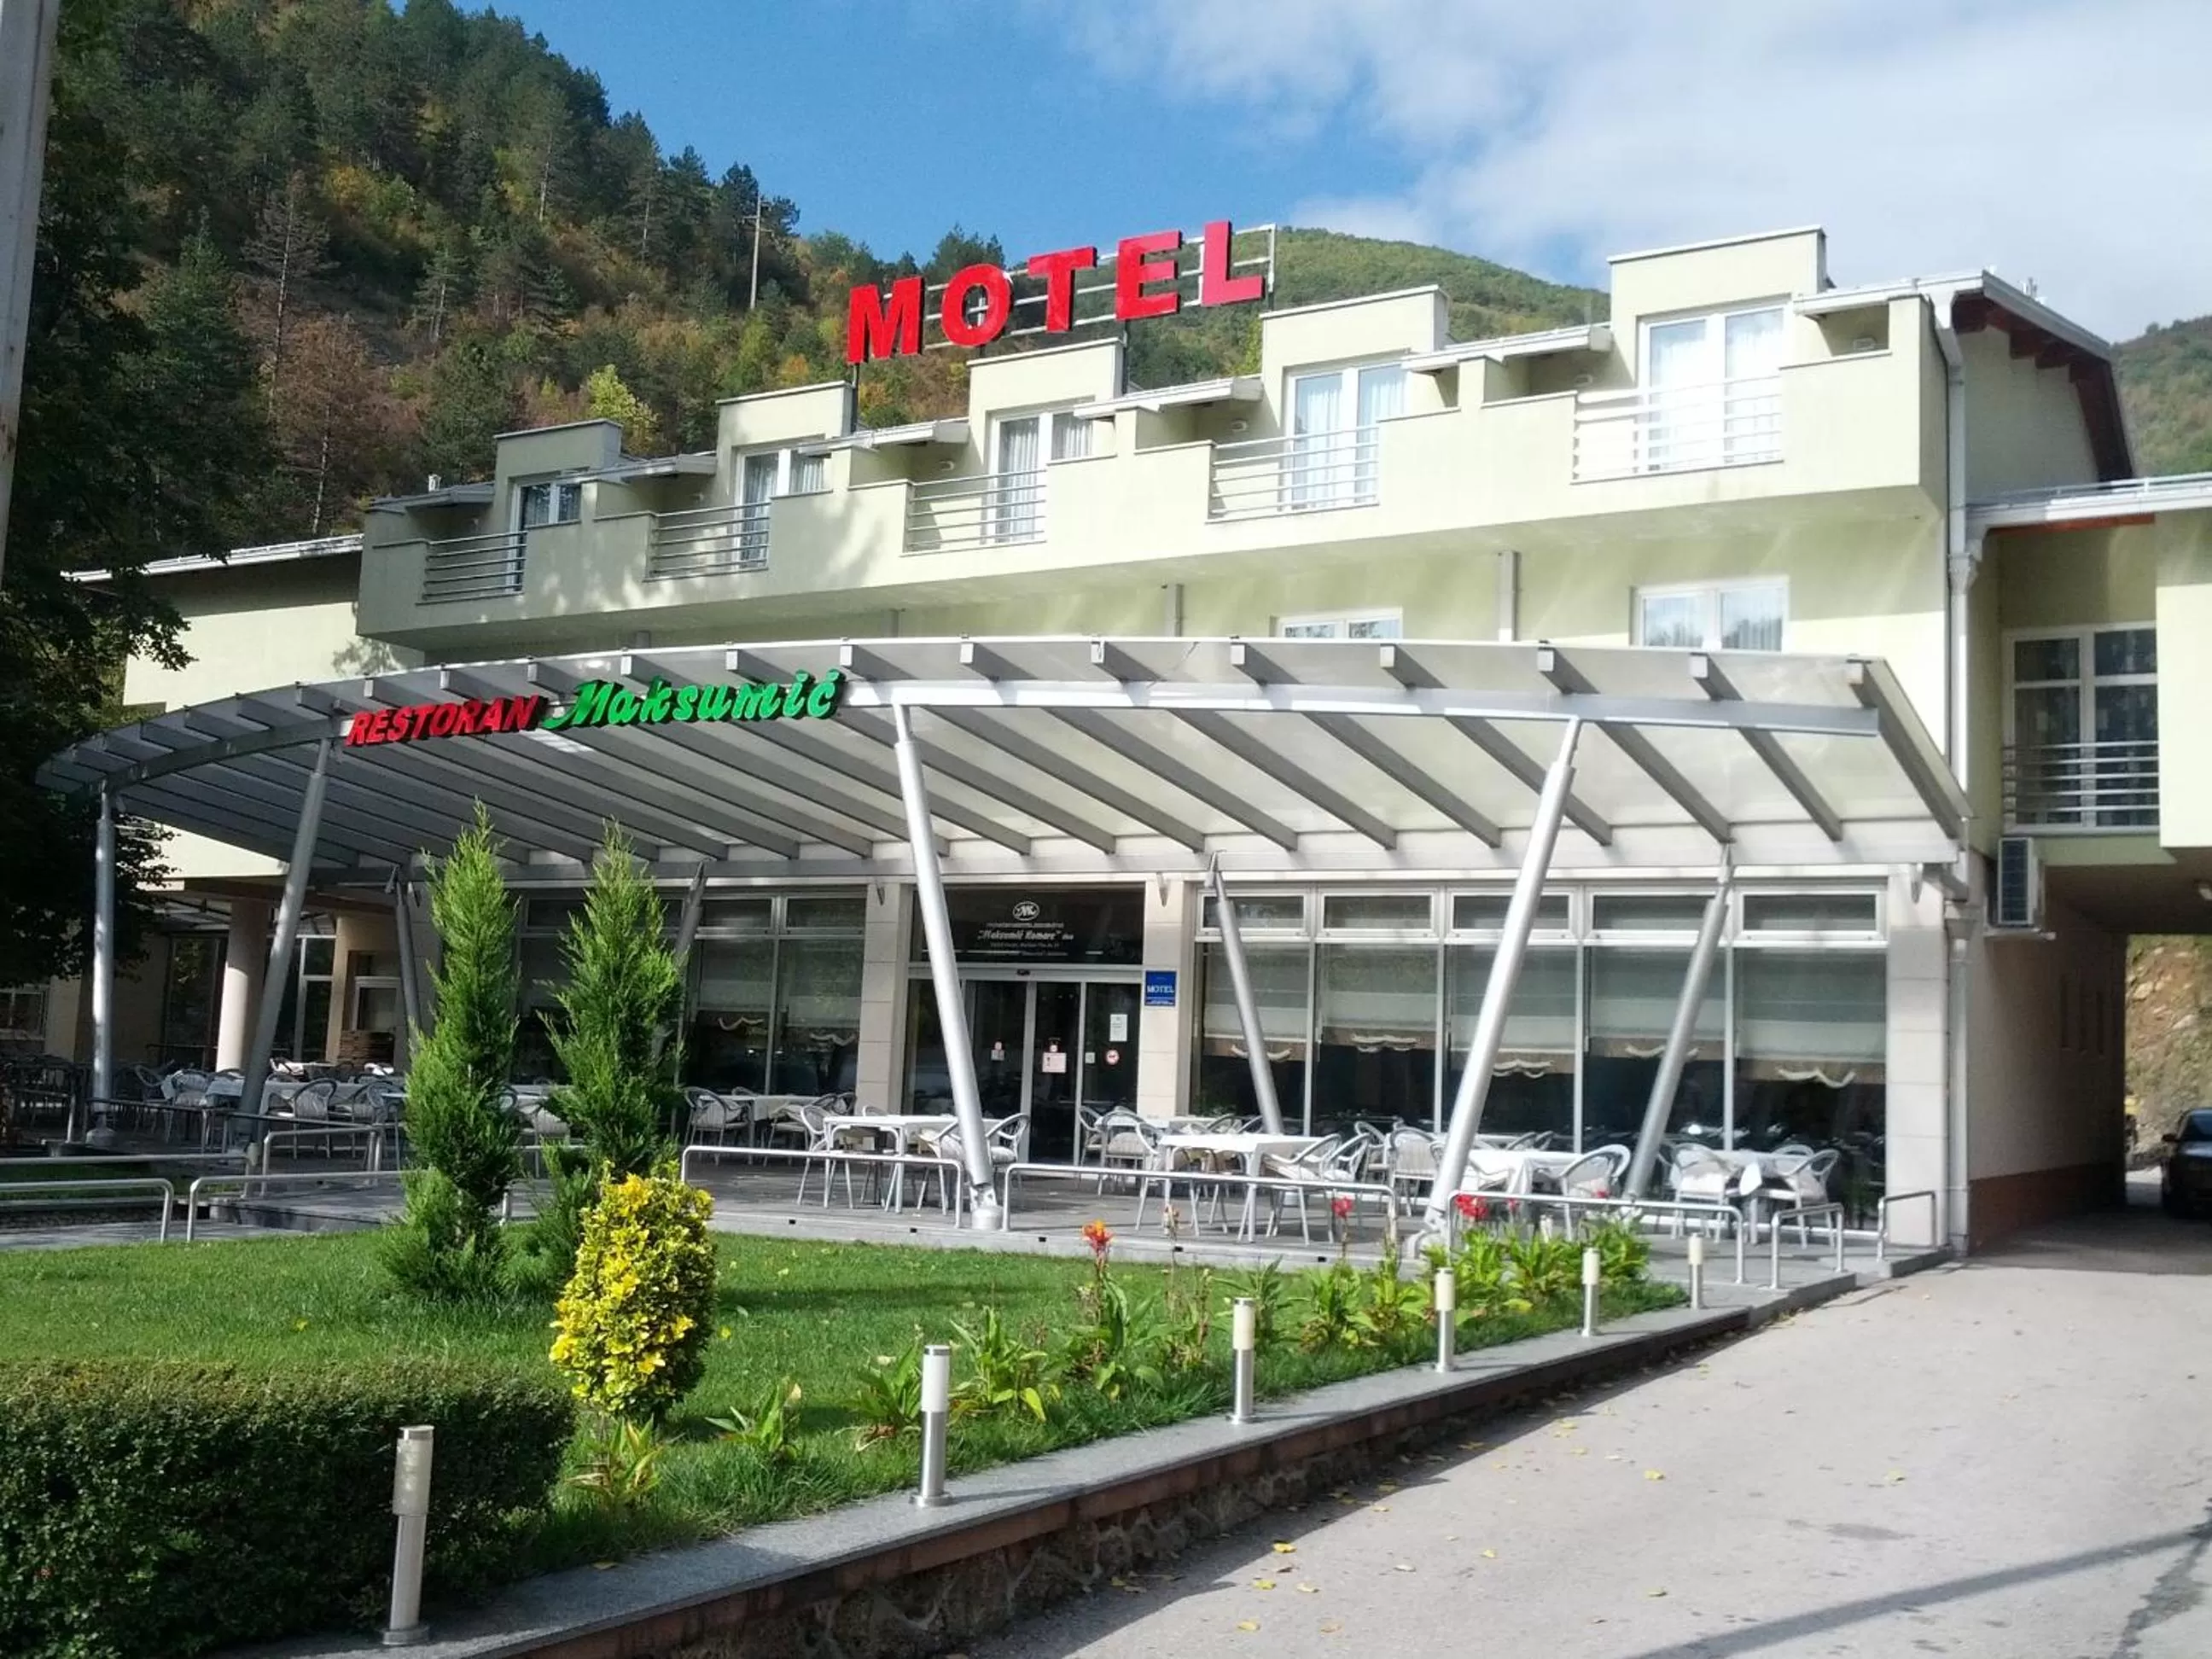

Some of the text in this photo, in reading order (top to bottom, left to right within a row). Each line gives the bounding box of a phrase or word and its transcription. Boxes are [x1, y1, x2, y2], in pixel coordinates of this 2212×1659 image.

[847, 219, 1266, 364] MOTEL
[346, 668, 845, 747] RESTORAN Maksumić
[1146, 984, 1175, 994] MOTEL
